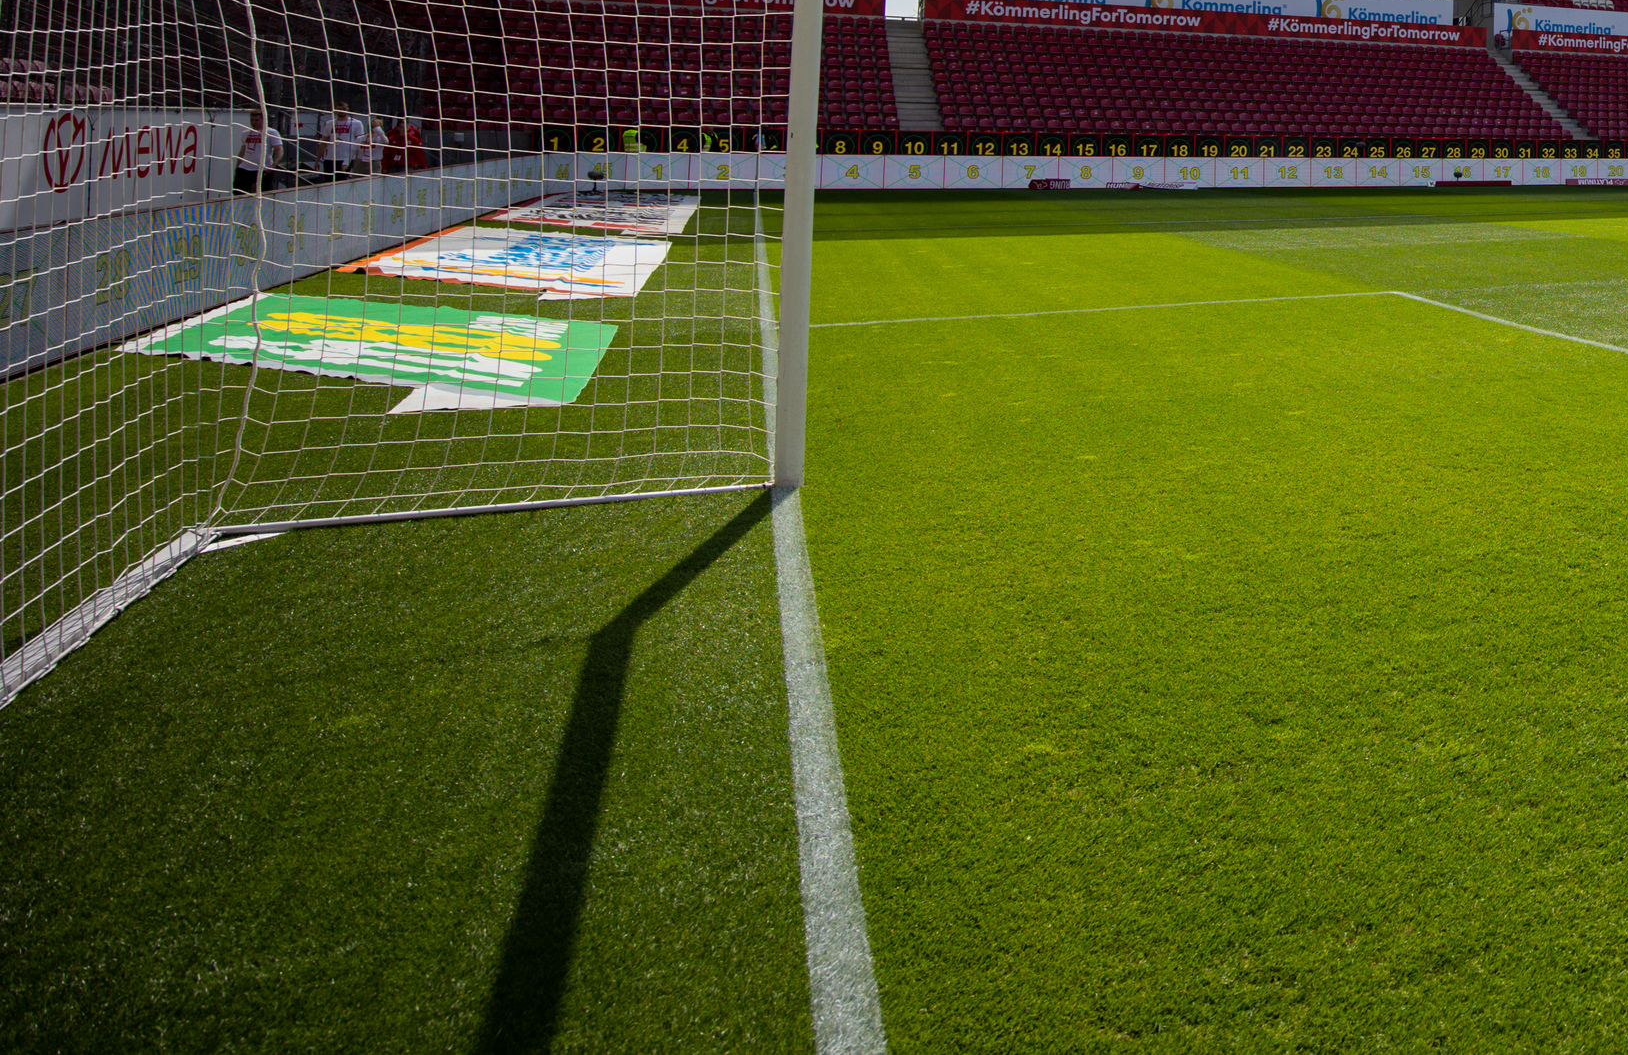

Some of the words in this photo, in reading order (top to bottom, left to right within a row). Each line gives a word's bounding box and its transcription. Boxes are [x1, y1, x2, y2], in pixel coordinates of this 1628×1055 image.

[965, 0, 1201, 27] #KömmerlingForTomorrow
[1267, 18, 1460, 41] #KömmerlingForTomorrow
[550, 136, 559, 150] 1
[592, 137, 605, 151] 2
[677, 138, 689, 152] 4
[718, 139, 730, 153] 5
[835, 140, 846, 154] 8
[872, 141, 883, 155] 9
[904, 141, 925, 155] 10
[940, 142, 958, 155] 11
[975, 142, 995, 156] 12
[1010, 142, 1029, 156] 13
[1043, 143, 1062, 156] 14
[1076, 143, 1094, 156] 15
[1109, 143, 1127, 157] 16
[1140, 144, 1158, 157] 17
[1171, 144, 1189, 157] 18
[1201, 145, 1218, 157] 19
[1230, 145, 1248, 158] 20
[1259, 145, 1275, 158] 21
[1287, 145, 1304, 158] 22
[1315, 146, 1332, 158] 23
[1369, 146, 1385, 158] 25
[1396, 146, 1411, 158] 26
[1421, 146, 1436, 158] 27
[1446, 147, 1461, 159] 28
[1471, 147, 1485, 159] 29
[1495, 147, 1509, 159] 30
[1518, 147, 1531, 159] 31
[1541, 147, 1556, 159] 32
[1564, 147, 1578, 159] 33
[1586, 148, 1599, 159] 34
[1608, 148, 1621, 159] 35
[652, 164, 662, 180] 1
[716, 164, 731, 180] 2
[845, 164, 860, 179] 4
[908, 164, 921, 179] 5
[967, 165, 979, 179] 6
[1024, 165, 1036, 179] 7
[1081, 166, 1092, 180] 8
[1132, 166, 1144, 180] 9
[1179, 167, 1201, 180] 10
[1230, 167, 1249, 180] 11
[1278, 166, 1298, 179] 12
[1324, 166, 1343, 179] 13
[1369, 166, 1386, 179] 14
[1412, 166, 1430, 179] 15
[1494, 166, 1511, 178] 17
[1534, 166, 1550, 177] 18
[1573, 166, 1587, 178] 19
[1608, 165, 1624, 177] 20
